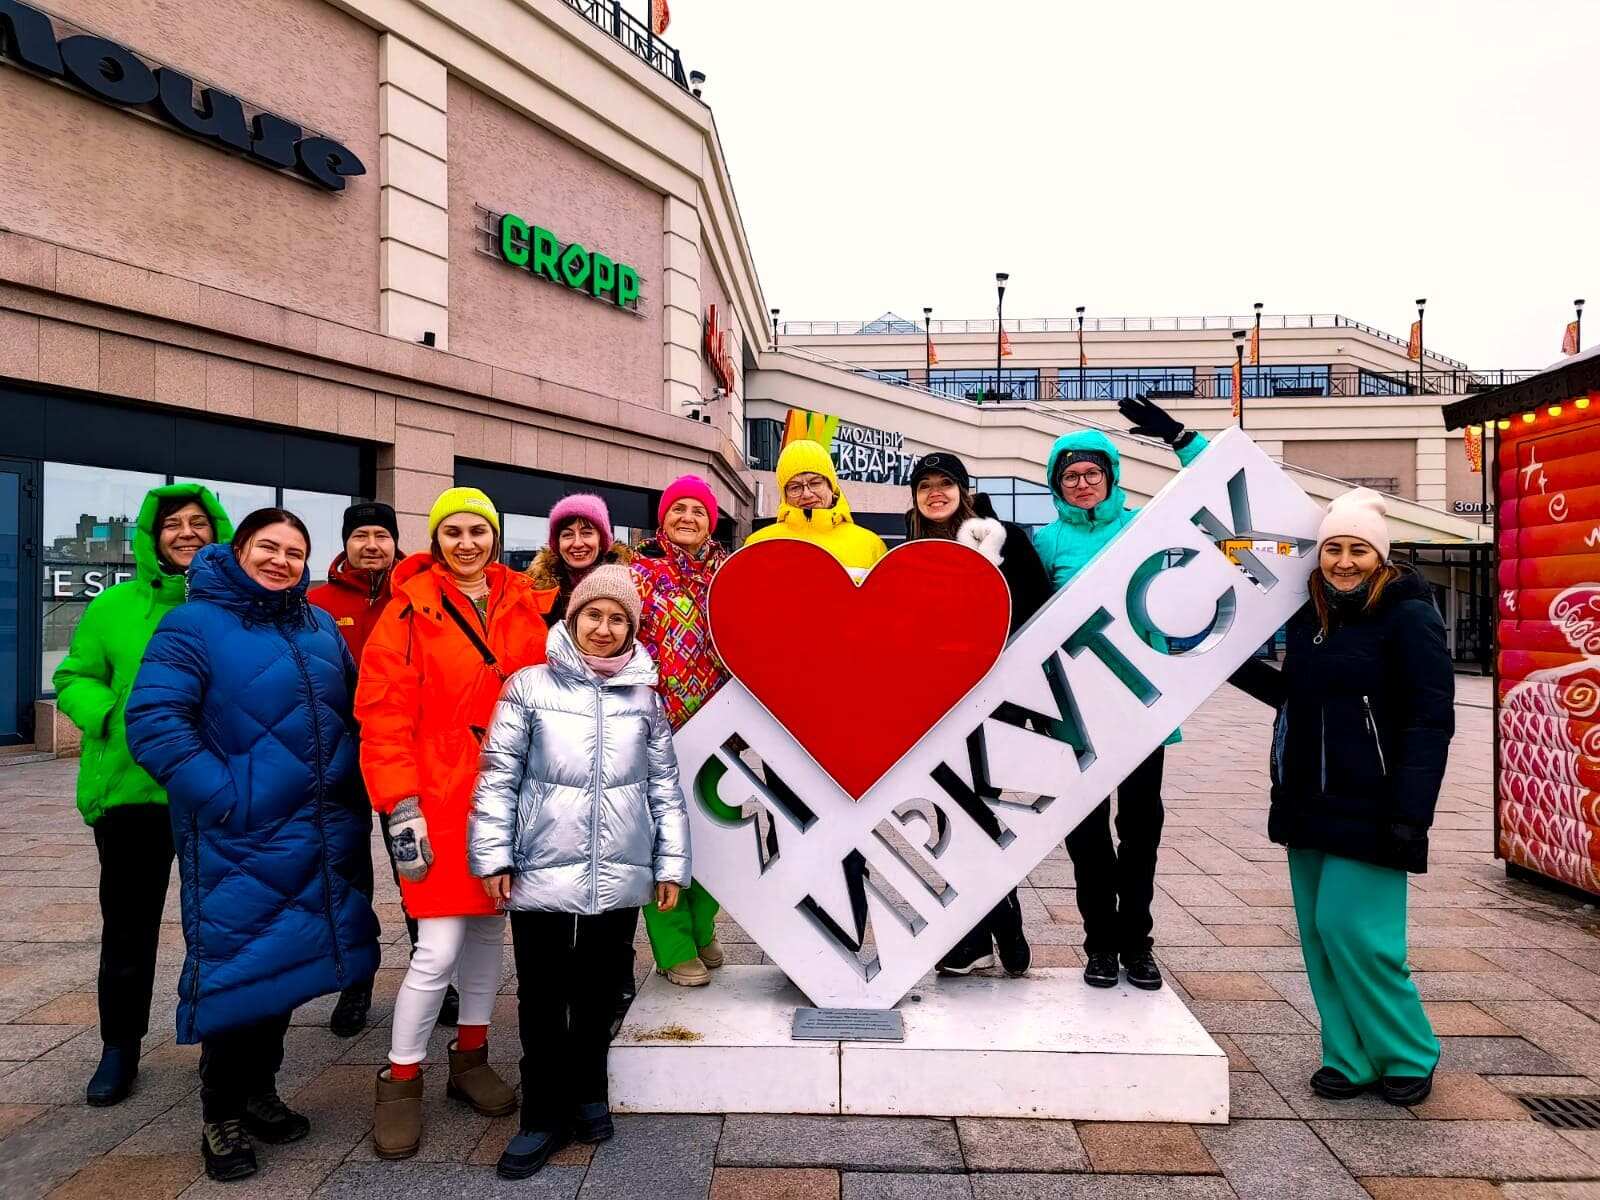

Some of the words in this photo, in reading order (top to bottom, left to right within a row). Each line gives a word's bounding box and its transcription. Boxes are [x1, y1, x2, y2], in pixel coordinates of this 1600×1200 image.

[499, 213, 640, 308] CROPP
[839, 425, 904, 448] МОДНЫЙ
[794, 467, 1316, 982] ИРКУТСК
[692, 732, 820, 877] Я
